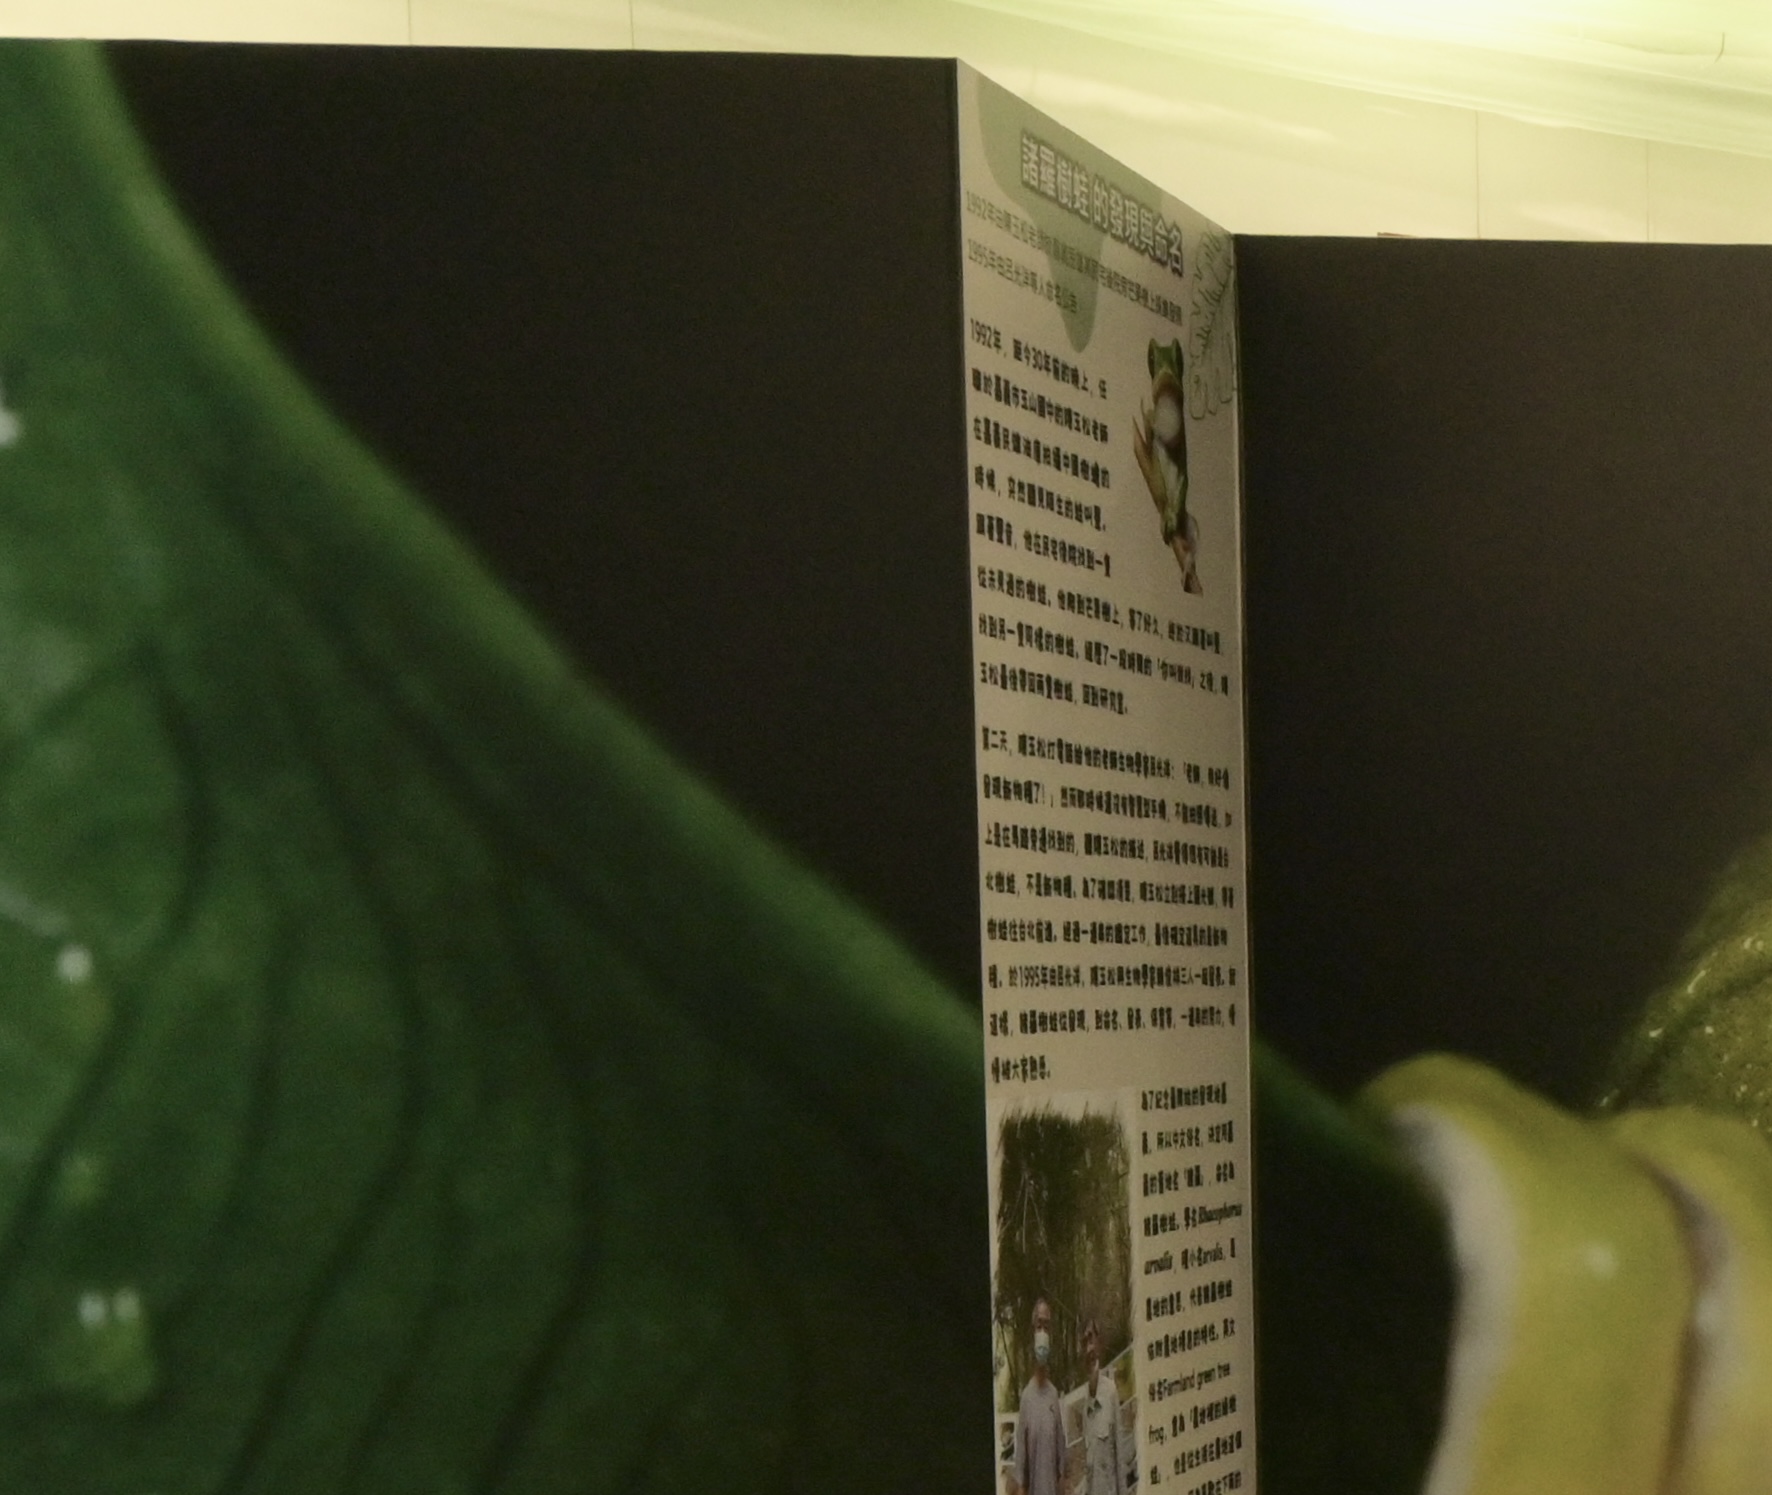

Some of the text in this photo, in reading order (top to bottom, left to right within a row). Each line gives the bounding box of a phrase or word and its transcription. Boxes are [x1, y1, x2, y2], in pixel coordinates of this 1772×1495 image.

[1021, 136, 1182, 277] 諸羅樹蛙 的發現與命名
[1196, 1365, 1215, 1390] green
[1217, 1357, 1229, 1379] tree
